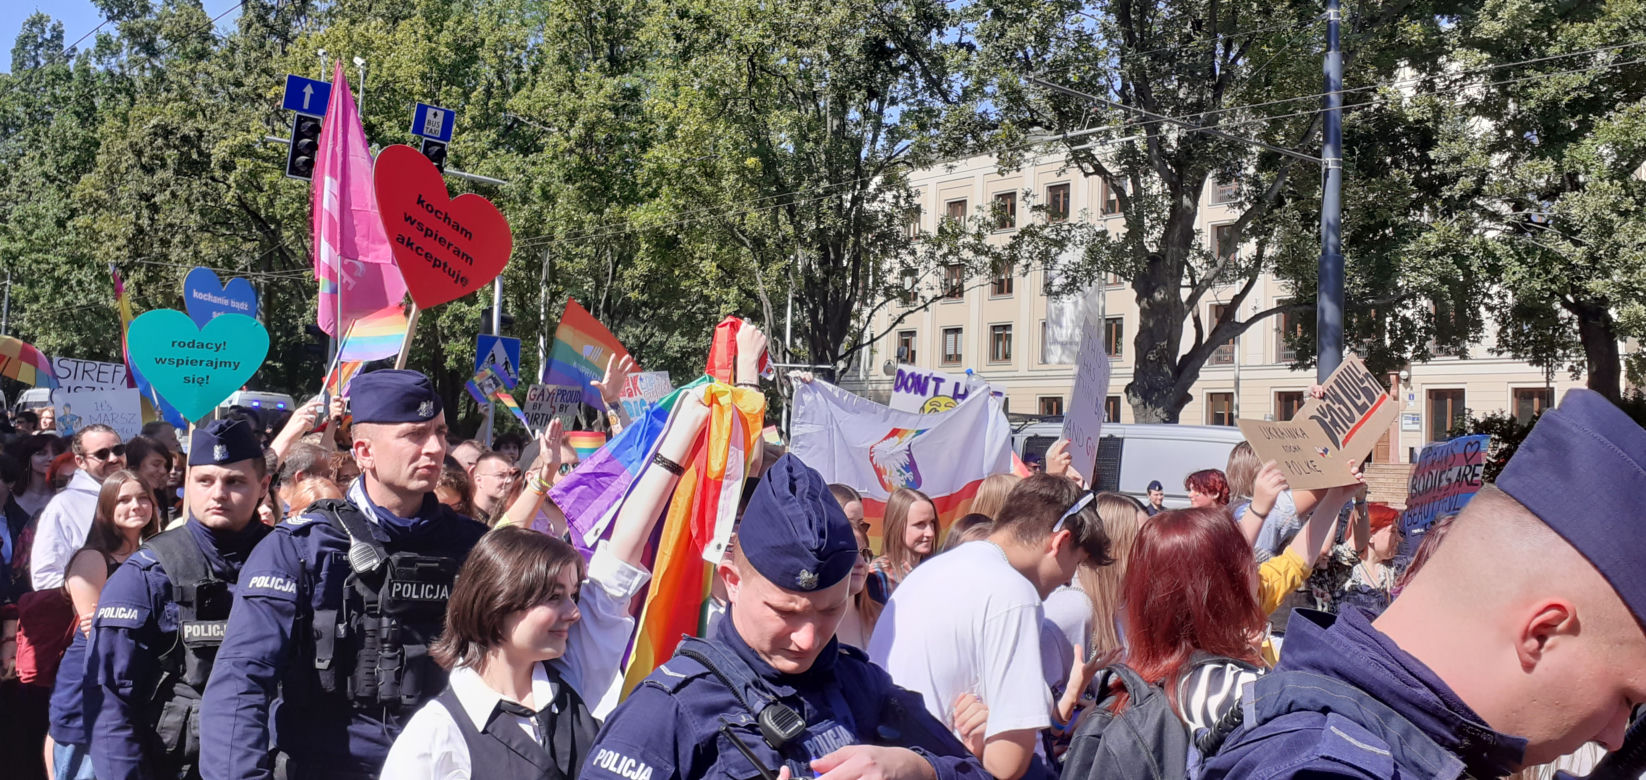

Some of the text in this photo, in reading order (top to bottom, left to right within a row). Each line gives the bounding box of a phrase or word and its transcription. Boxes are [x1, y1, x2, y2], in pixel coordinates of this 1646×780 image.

[425, 127, 440, 136] TAXI
[427, 119, 440, 128] BUS
[416, 193, 473, 240] kocham
[403, 212, 474, 266] wspieram
[395, 233, 469, 287] akceptuję
[192, 289, 229, 306] kochanie
[171, 339, 227, 352] rodacy!
[154, 356, 241, 371] wspierajmy
[183, 374, 210, 387] się!
[528, 387, 581, 403] GAY PROUD
[532, 402, 543, 410] BY
[559, 403, 570, 413] BY
[1410, 463, 1483, 499] BODIES ARE
[248, 575, 297, 594] POLICJA
[391, 582, 449, 600] POLICJA
[97, 607, 138, 620] POLICJA
[184, 624, 228, 638] POLICJ
[804, 725, 856, 757] POLICJA
[592, 748, 654, 780] POLICJA
